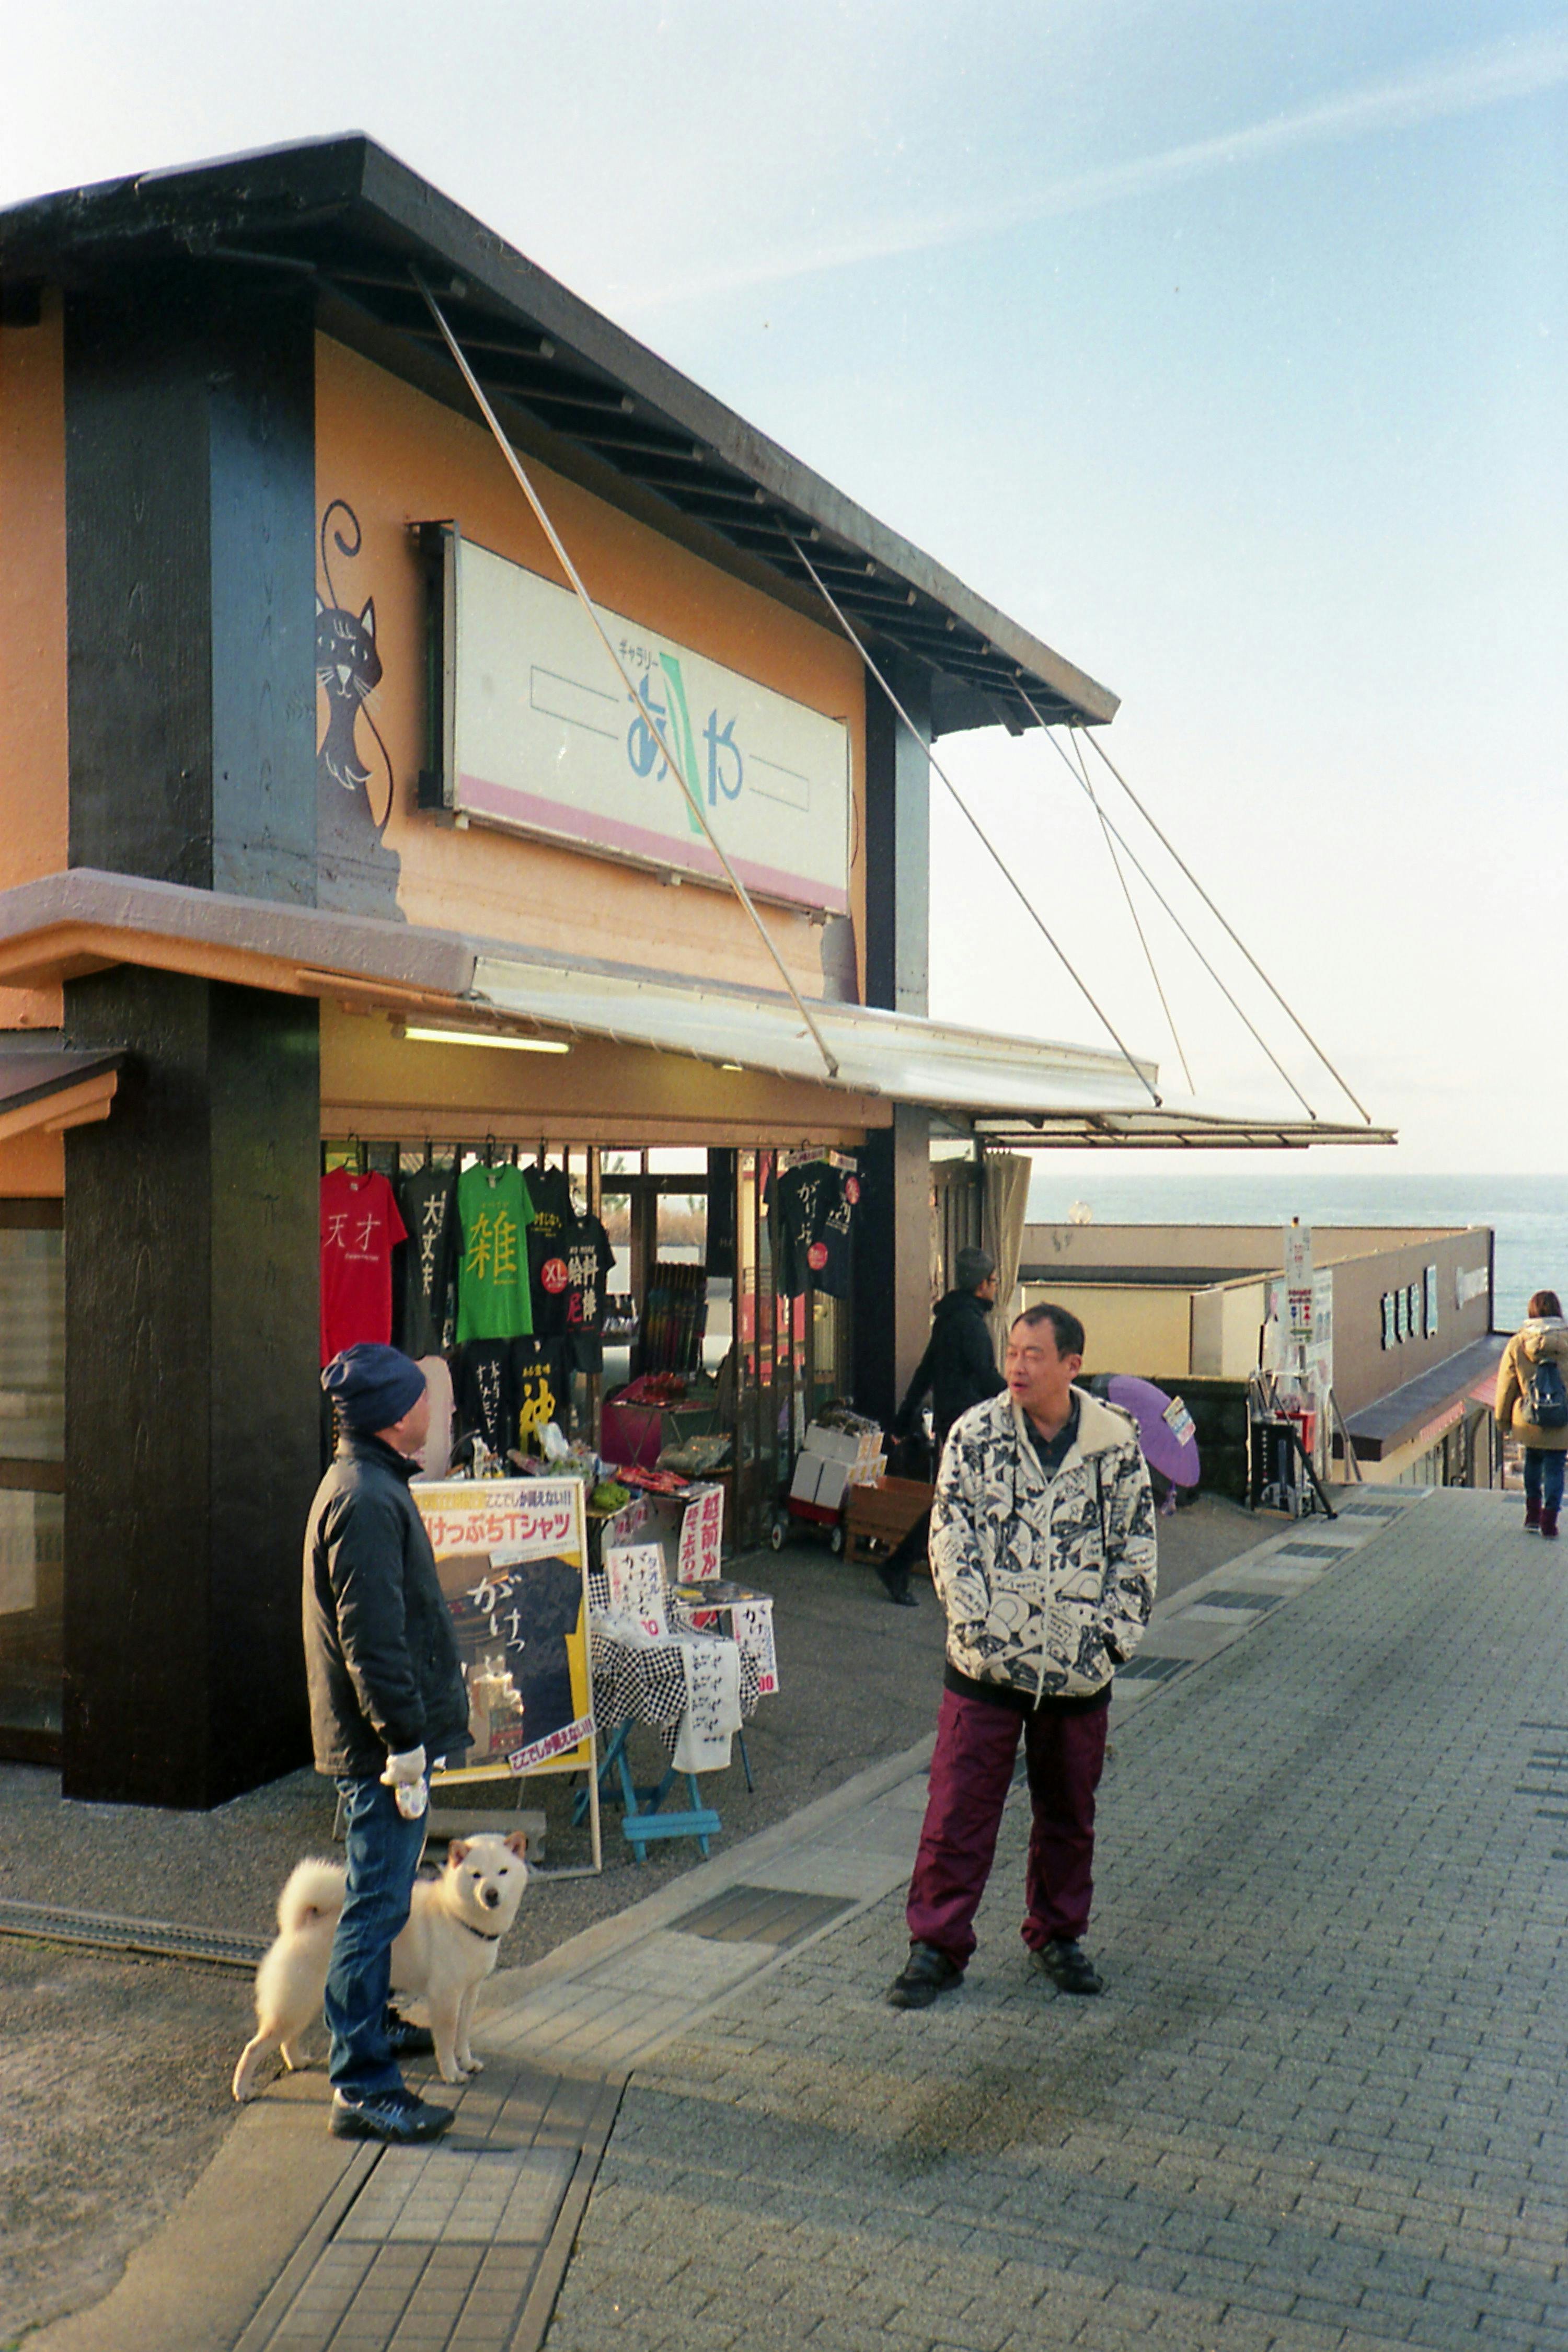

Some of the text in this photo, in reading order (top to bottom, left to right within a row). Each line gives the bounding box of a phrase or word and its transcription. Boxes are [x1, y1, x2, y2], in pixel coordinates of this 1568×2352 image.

[324, 1213, 382, 1252] 天才
[421, 1194, 444, 1296] 大丈夫
[466, 1210, 517, 1278] 雑
[545, 1263, 567, 1283] XL
[421, 1513, 571, 1546] けっぷちTシャツ
